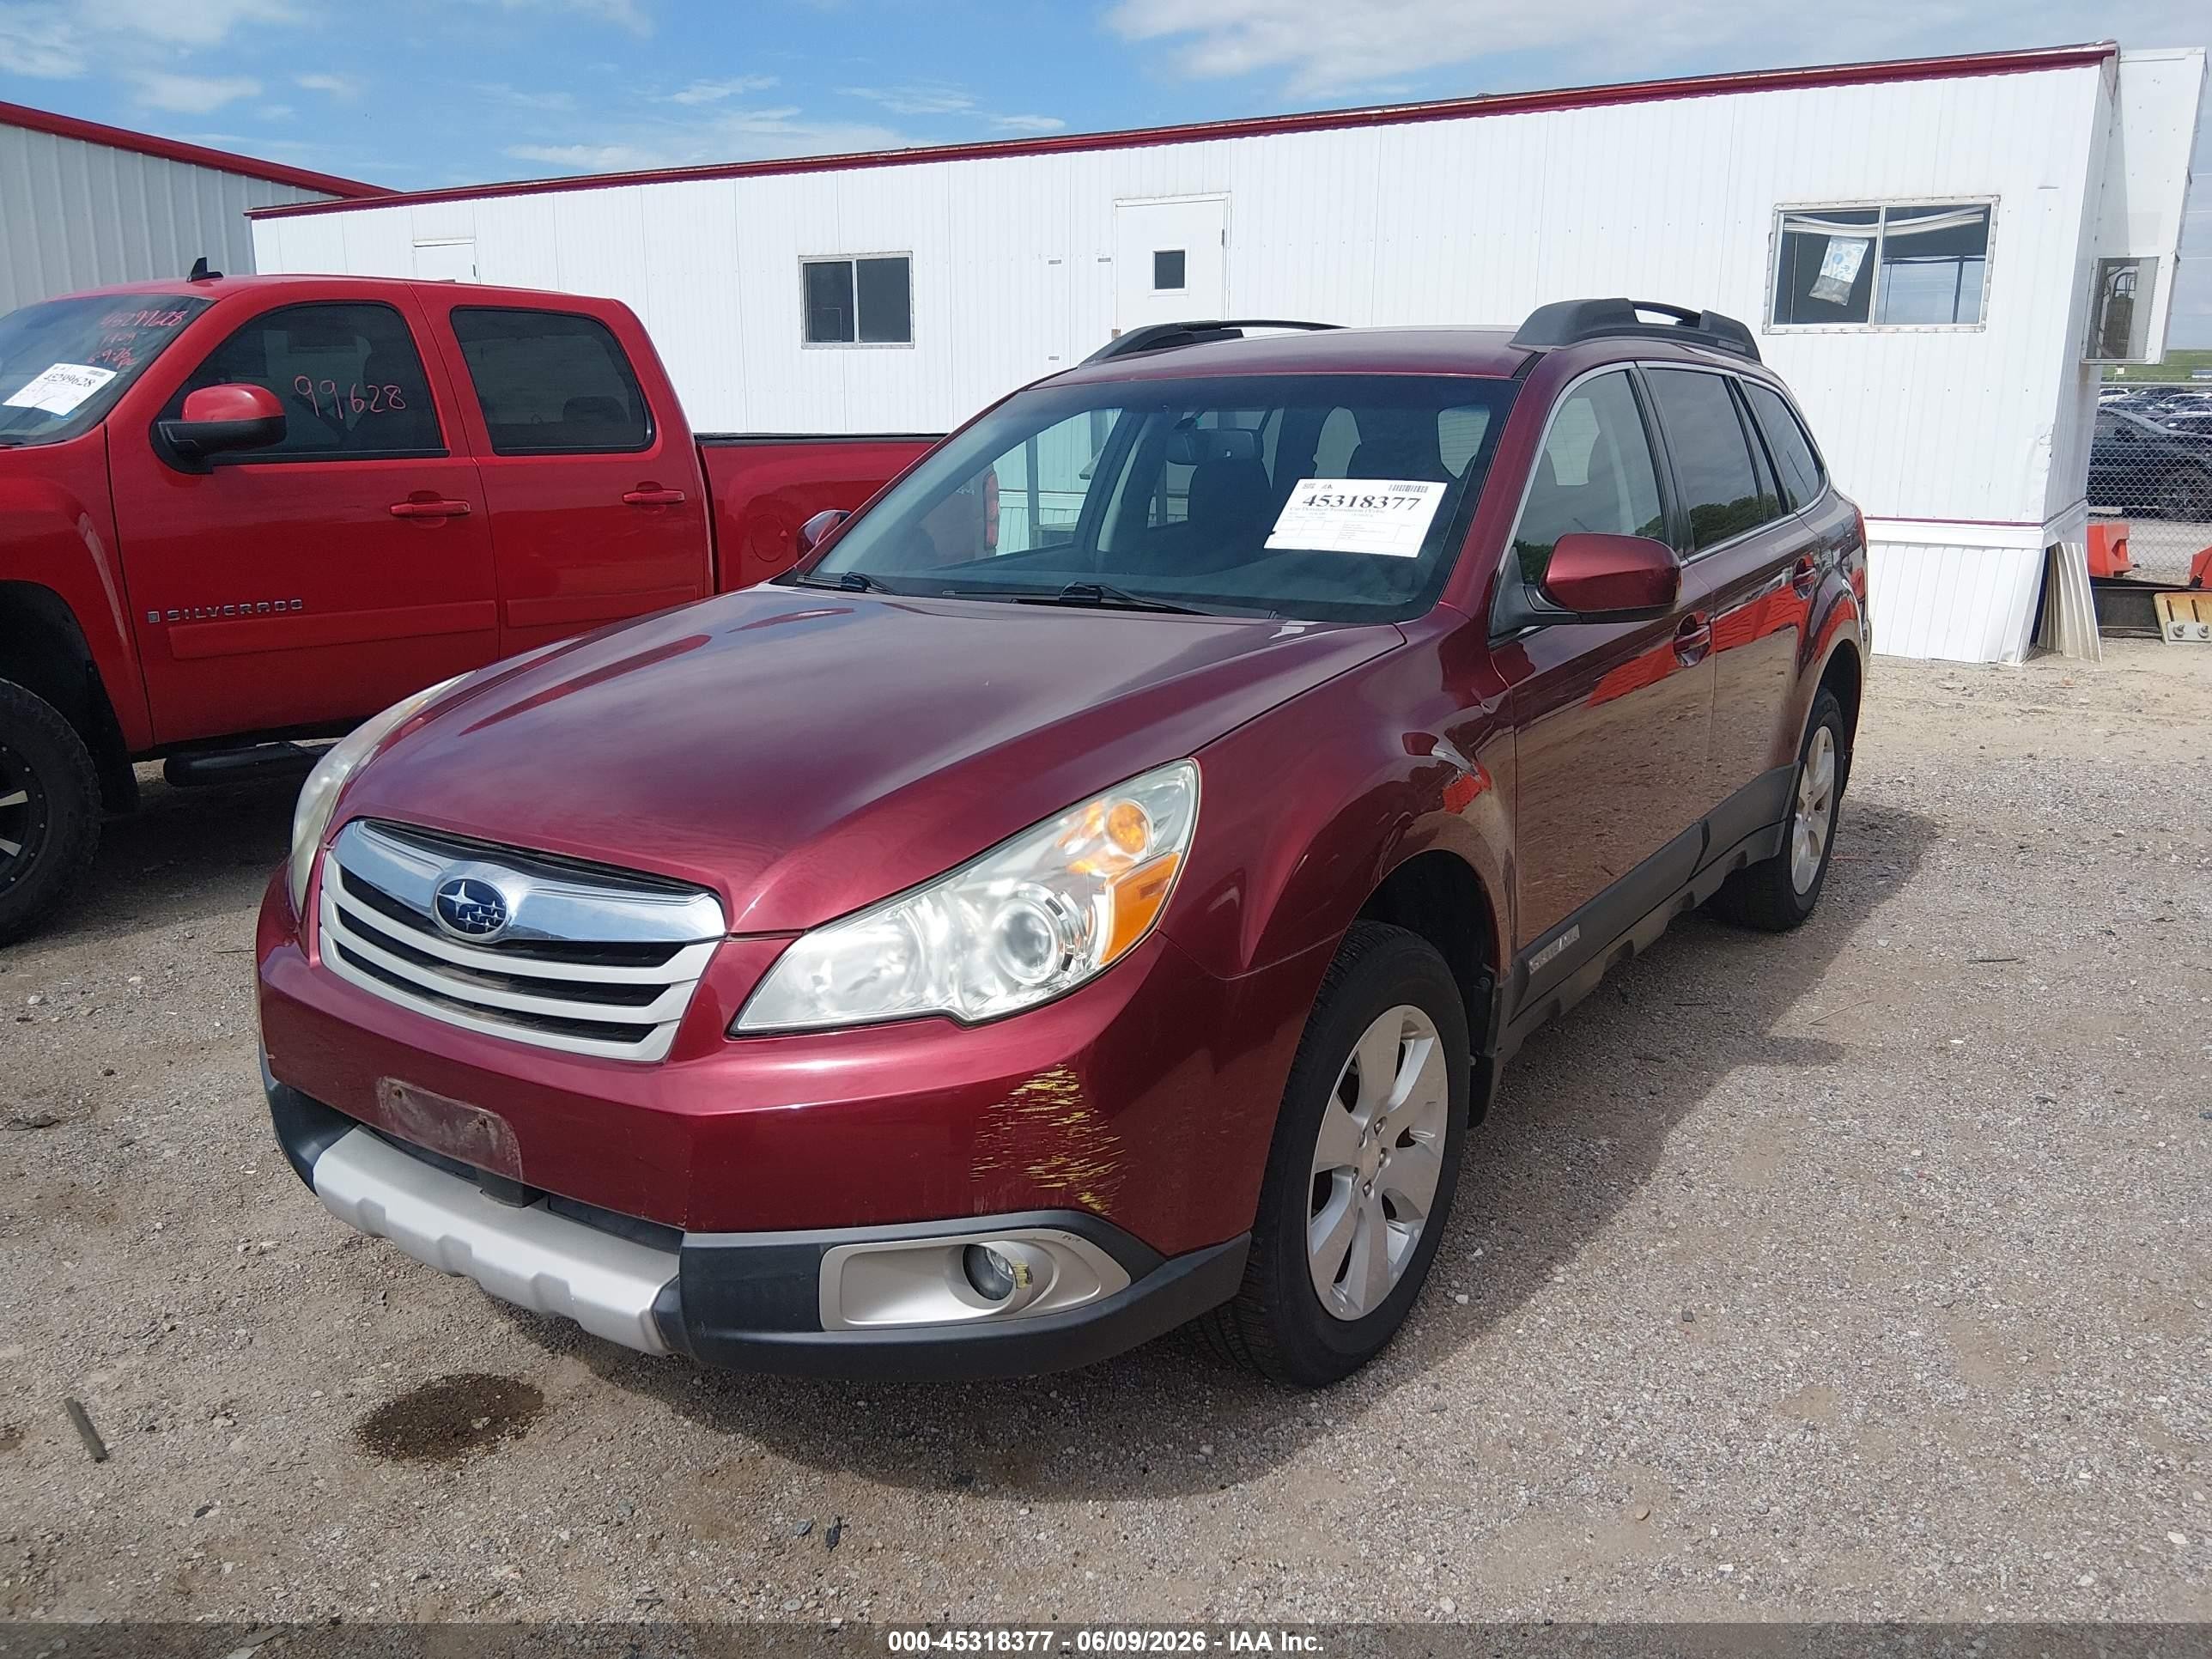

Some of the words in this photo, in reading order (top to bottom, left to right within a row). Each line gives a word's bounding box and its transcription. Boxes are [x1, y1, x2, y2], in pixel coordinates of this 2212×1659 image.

[295, 375, 406, 420] 99628
[1303, 494, 1421, 511] 45318377
[167, 599, 303, 622] SILVERADO
